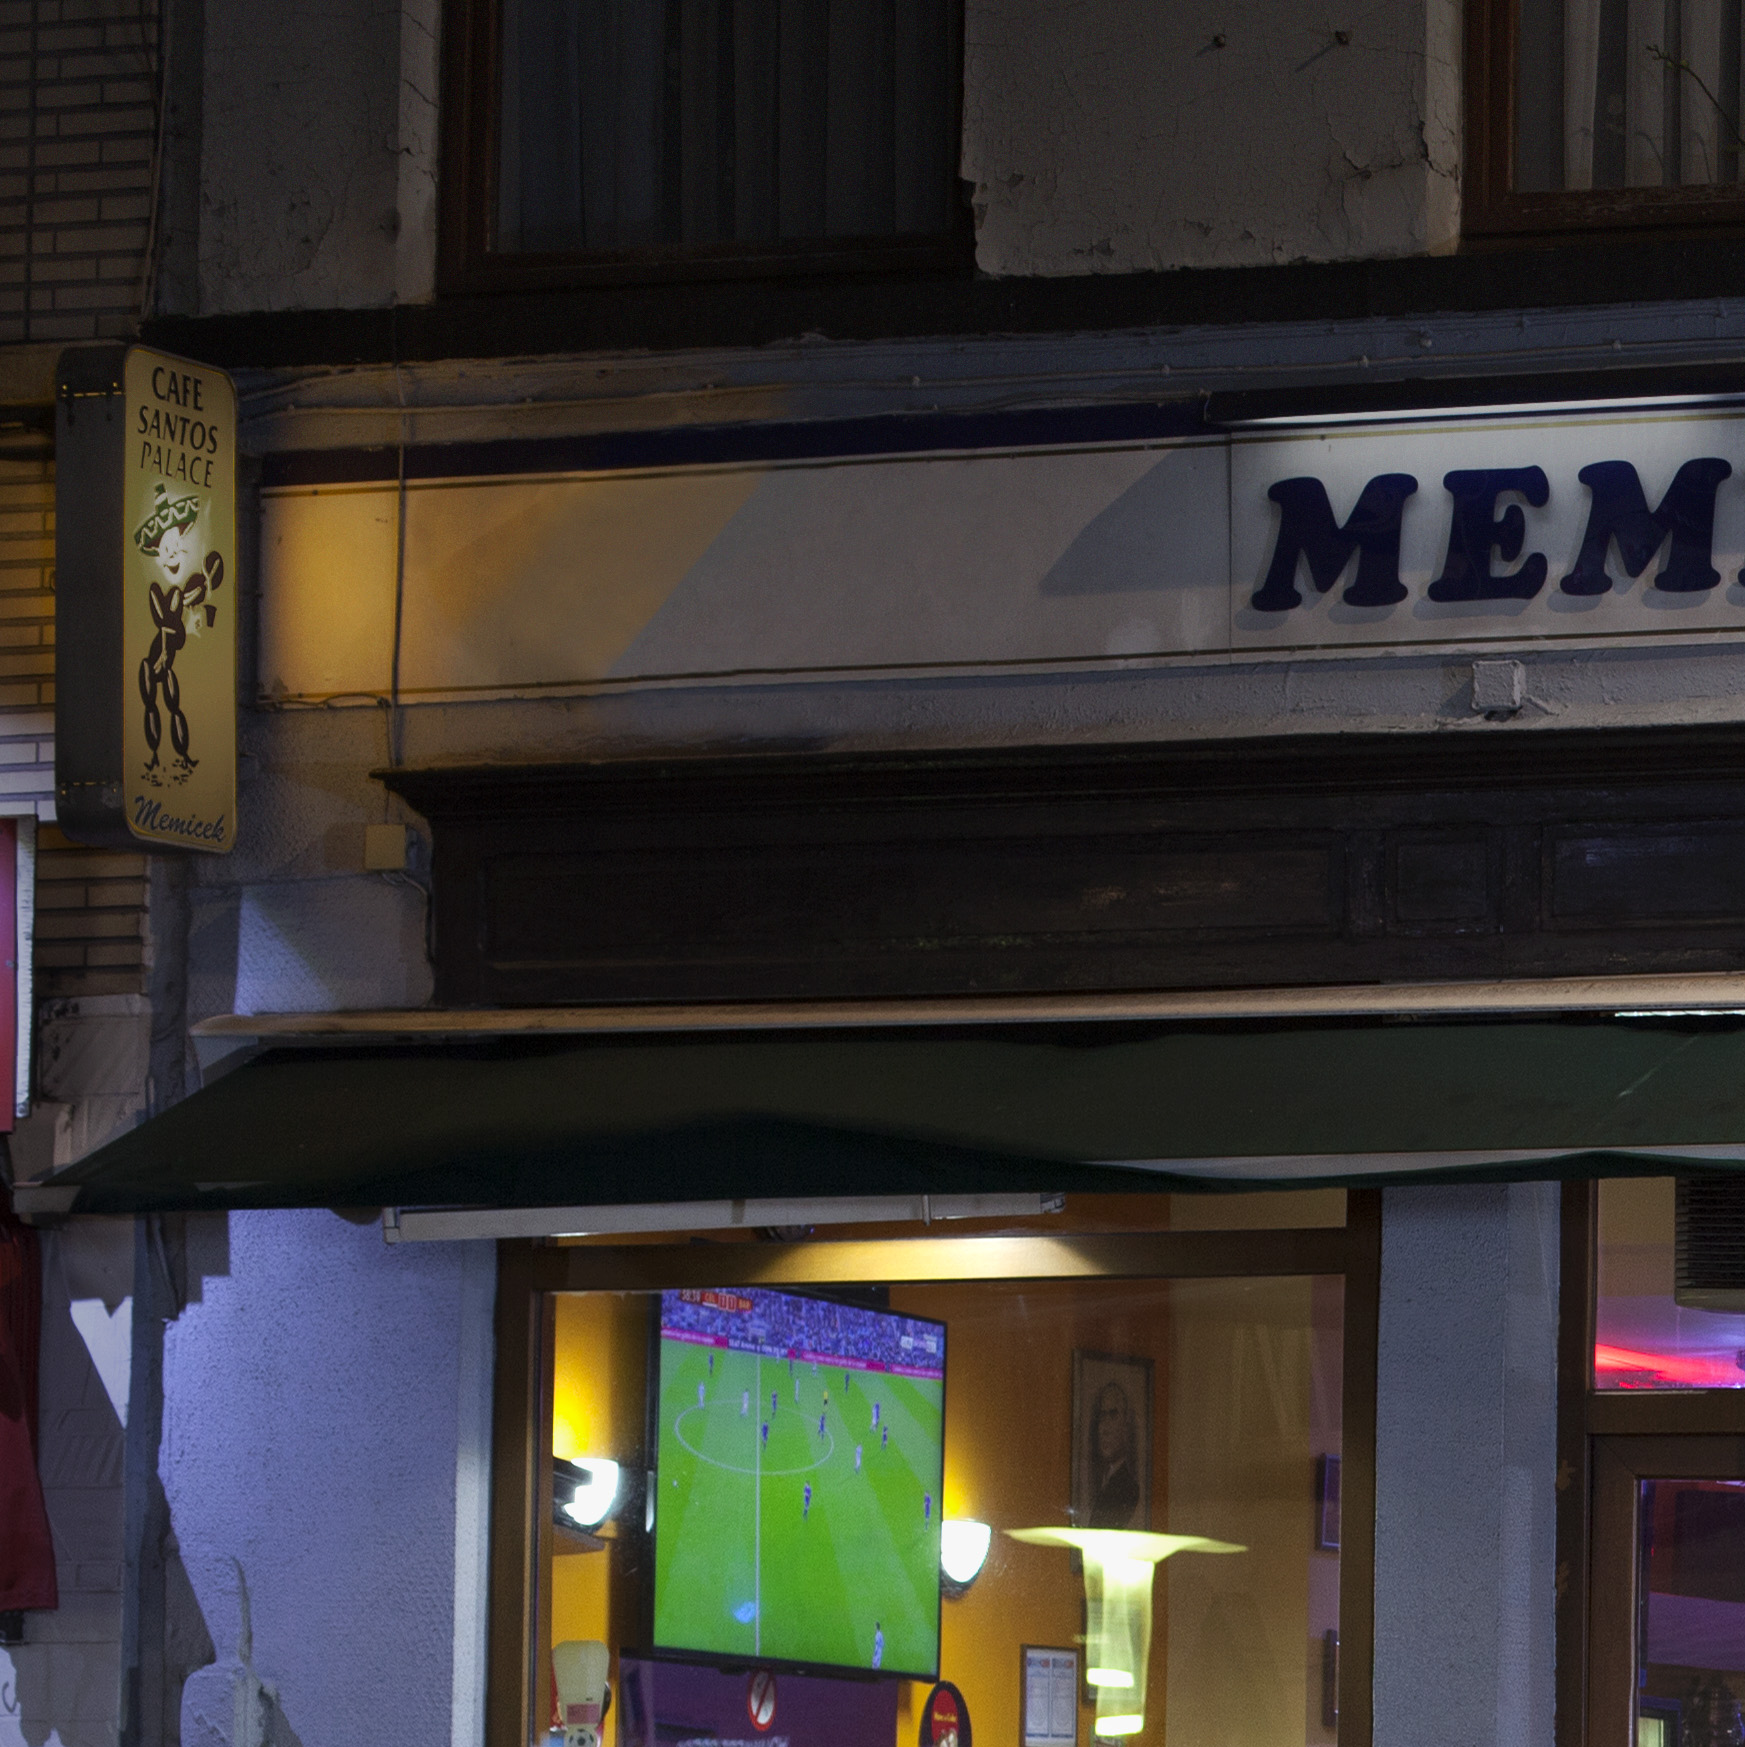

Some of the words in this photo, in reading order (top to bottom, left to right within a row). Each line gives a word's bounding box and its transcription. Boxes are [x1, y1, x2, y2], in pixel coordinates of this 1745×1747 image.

[152, 366, 203, 411] CAFE
[138, 405, 218, 454] SANTOS
[140, 441, 213, 488] PALACE
[135, 795, 226, 843] Memicek
